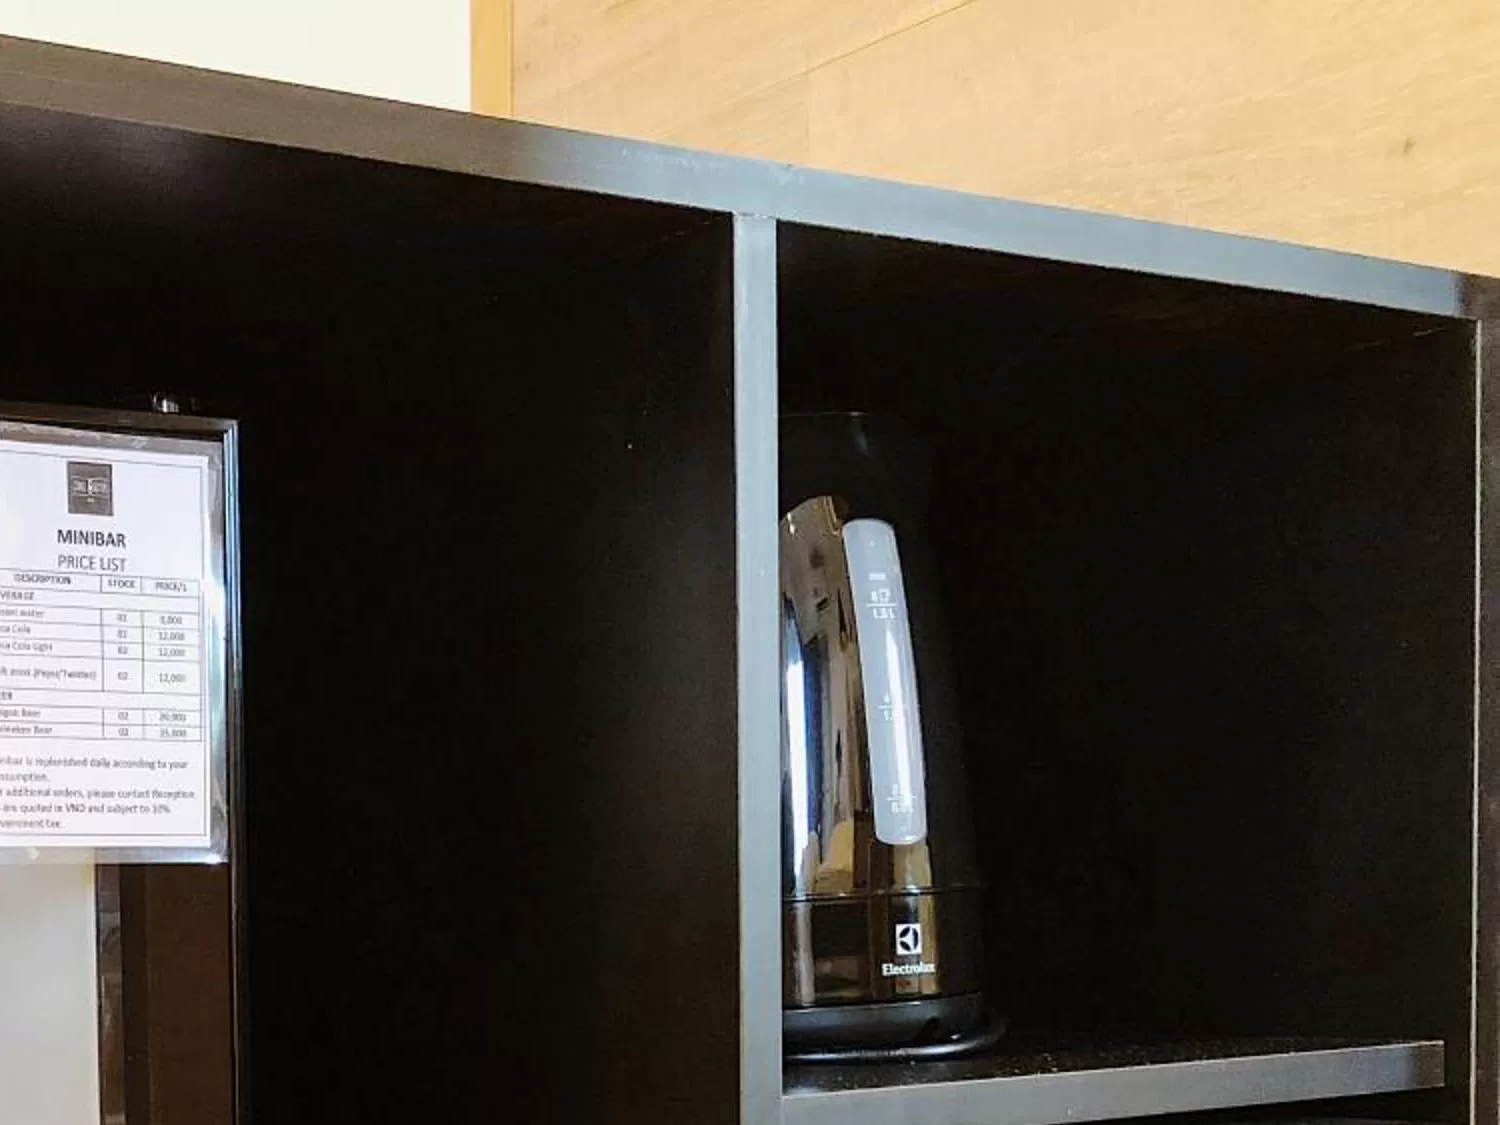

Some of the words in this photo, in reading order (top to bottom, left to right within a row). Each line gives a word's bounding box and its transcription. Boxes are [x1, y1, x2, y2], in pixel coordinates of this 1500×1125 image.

[57, 529, 126, 548] MINIBAR
[58, 555, 96, 570] PRICE
[100, 558, 127, 572] LIST
[14, 574, 71, 584] DESCRIPTION
[12, 626, 31, 635] Cola
[12, 642, 32, 651] Cola
[119, 712, 128, 720] 02
[36, 758, 87, 769] replenished
[90, 758, 110, 769] daily
[113, 759, 155, 771] according
[158, 760, 167, 769] to
[169, 762, 189, 771] your
[6, 789, 51, 797] additional
[118, 791, 149, 799] contact
[20, 805, 52, 814] quoted
[66, 804, 86, 813] VND
[89, 805, 104, 813] and
[107, 805, 137, 815] subject
[140, 805, 149, 813] to
[882, 961, 937, 977] Electrolux
